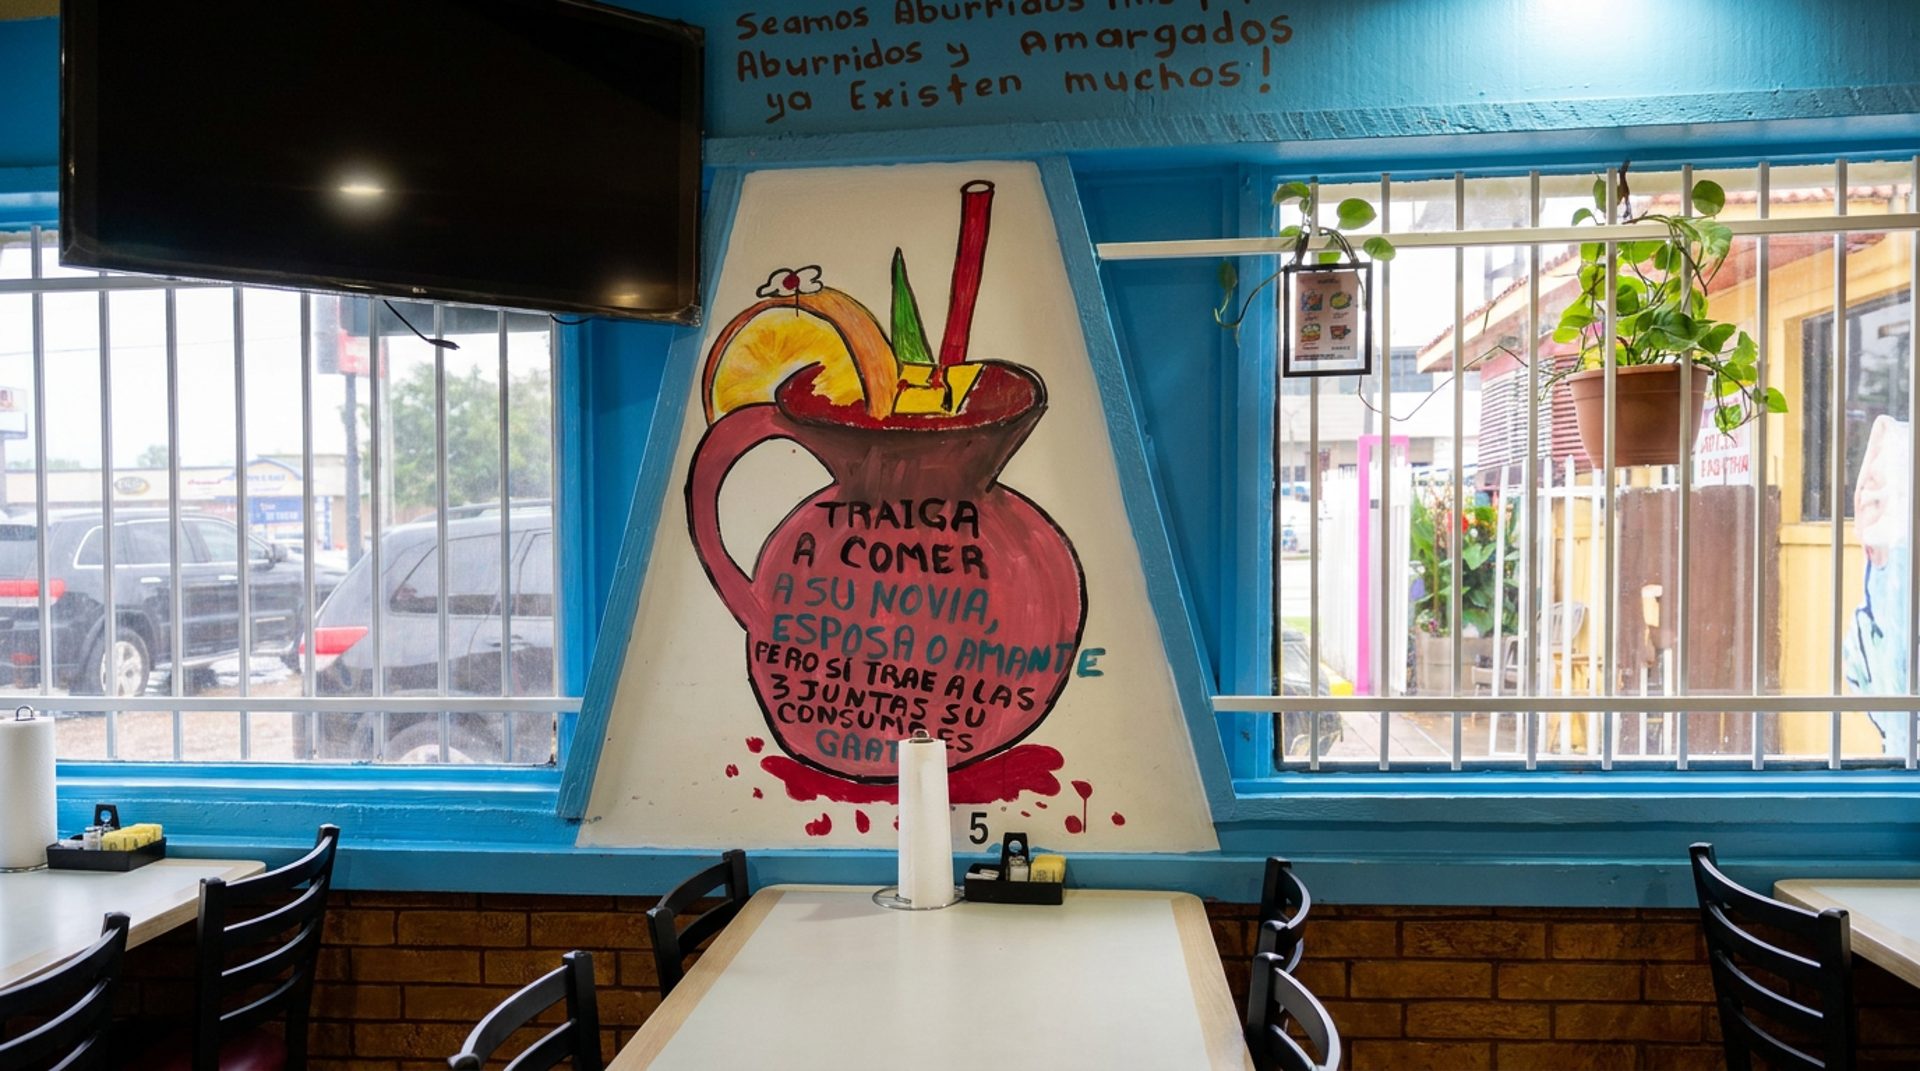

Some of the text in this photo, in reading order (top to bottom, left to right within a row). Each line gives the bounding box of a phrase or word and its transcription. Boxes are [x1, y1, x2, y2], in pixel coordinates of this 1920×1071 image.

[736, 8, 869, 41] Seamos
[736, 10, 1293, 82] Aburridos y Amargados
[764, 93, 812, 124] ya
[850, 75, 1022, 112] Existen
[815, 498, 980, 539] TRAIGA
[792, 532, 990, 579] A COMER
[771, 572, 1000, 635] A SU NOVIA,
[771, 613, 1107, 680] ESPOSA O AMANTE
[755, 640, 819, 672] PERO
[863, 660, 938, 692] TRAE
[945, 675, 966, 699] A
[972, 679, 1036, 711] LAS
[770, 673, 987, 728] 3 JUNTAS SU
[937, 728, 974, 753] ES
[969, 812, 989, 844] 5
